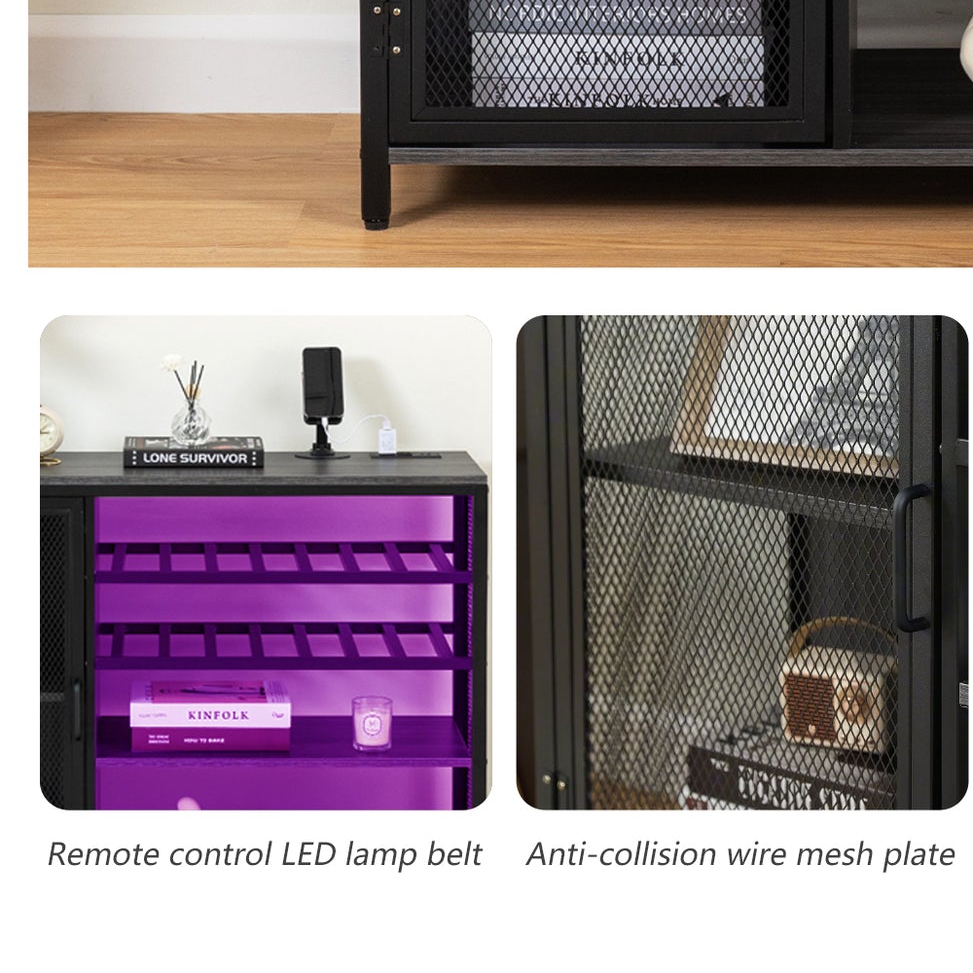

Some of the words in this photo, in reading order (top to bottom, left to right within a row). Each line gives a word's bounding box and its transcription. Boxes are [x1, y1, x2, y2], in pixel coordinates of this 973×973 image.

[575, 50, 685, 67] KINFOLK
[143, 452, 177, 463] LONE
[179, 453, 248, 464] SURVIVOR
[188, 710, 250, 721] KINFOLK
